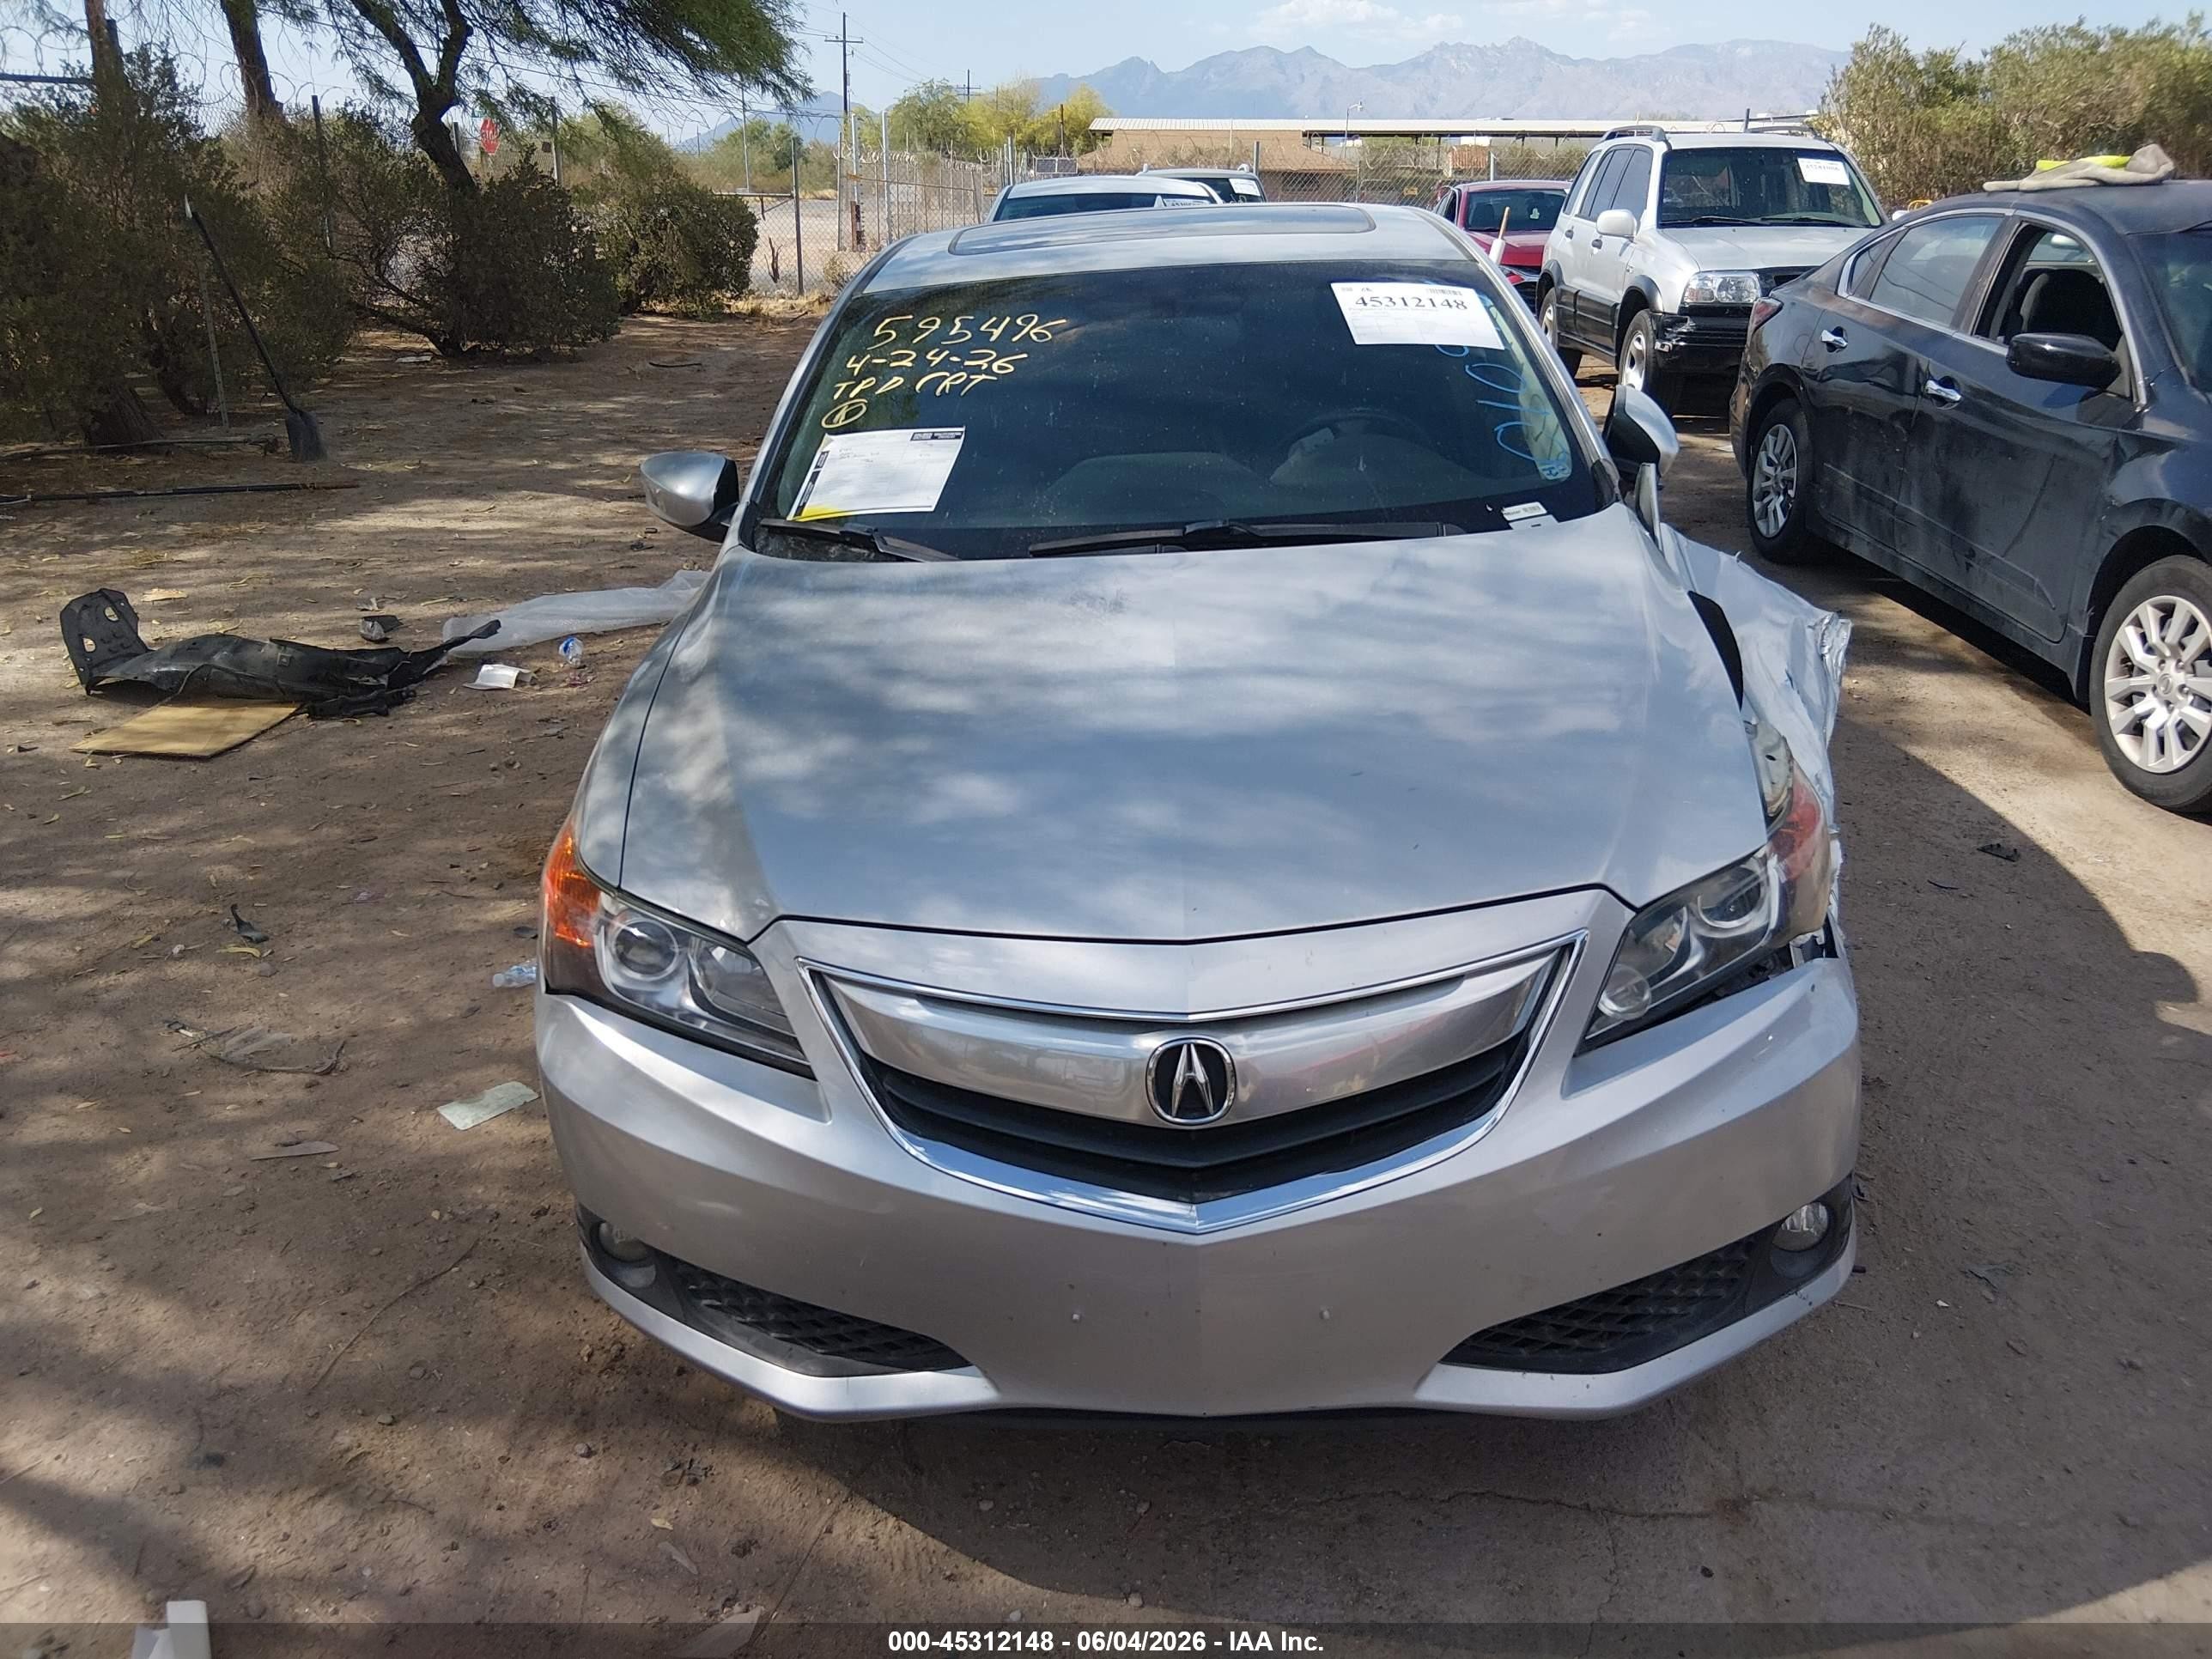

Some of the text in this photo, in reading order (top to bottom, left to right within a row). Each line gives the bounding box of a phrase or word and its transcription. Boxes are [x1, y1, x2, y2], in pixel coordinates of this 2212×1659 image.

[1355, 295, 1468, 311] 45312148
[866, 314, 1067, 349] 595496
[846, 348, 1028, 376] 4-24-26
